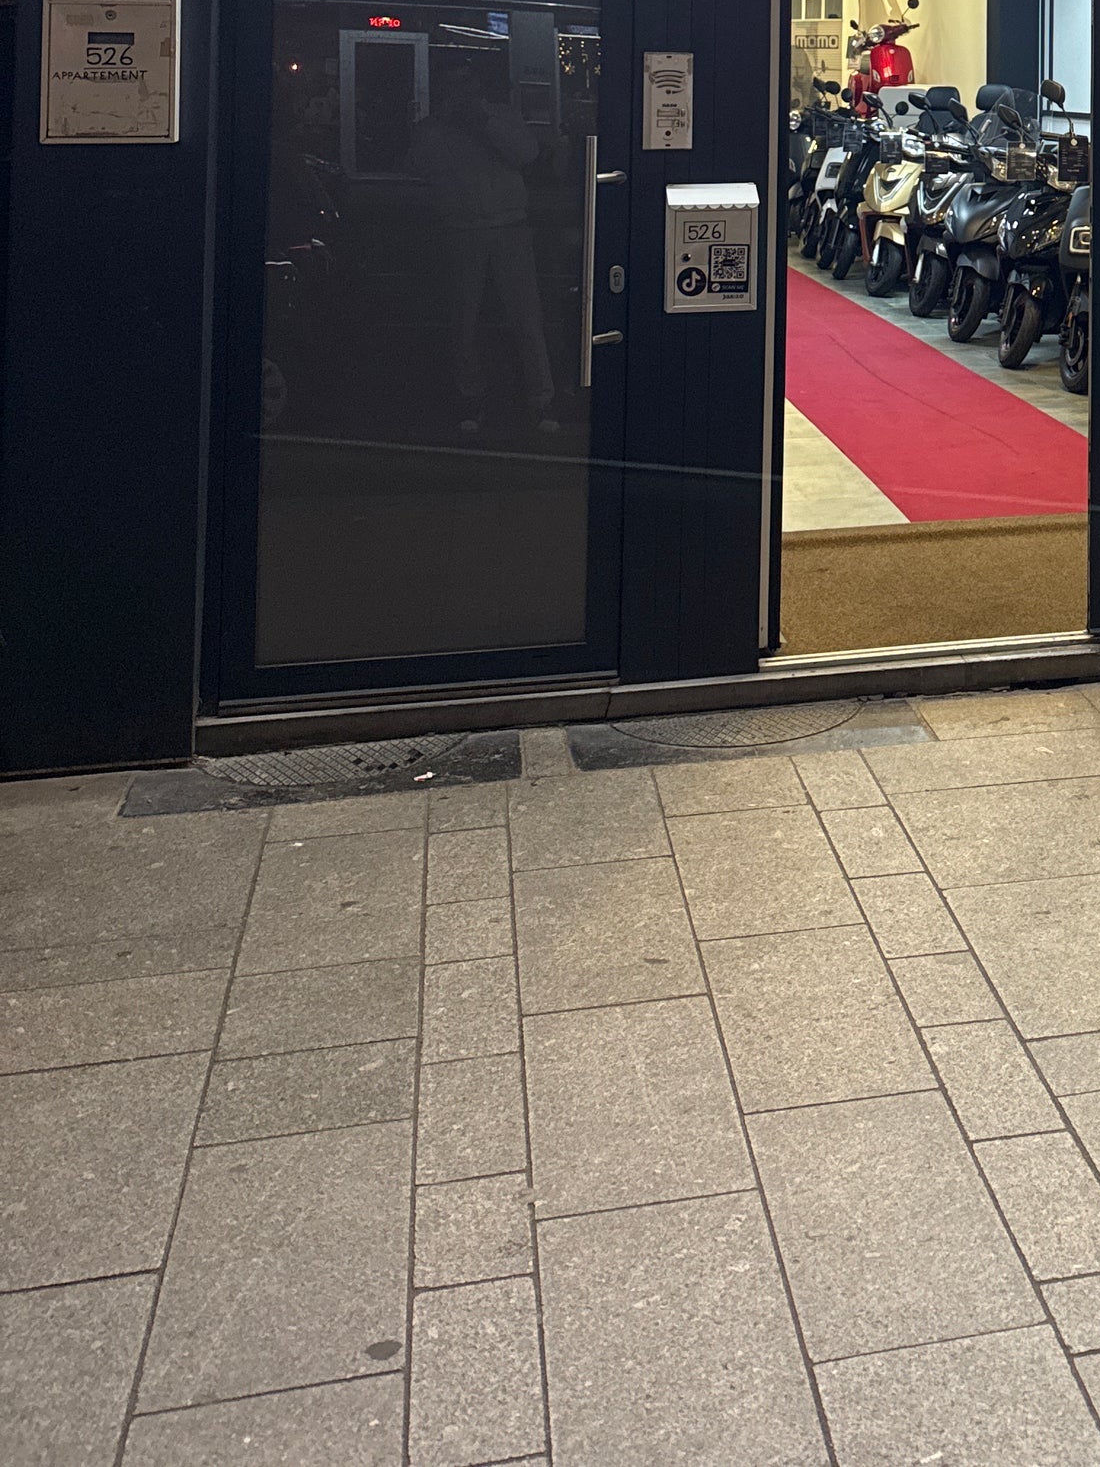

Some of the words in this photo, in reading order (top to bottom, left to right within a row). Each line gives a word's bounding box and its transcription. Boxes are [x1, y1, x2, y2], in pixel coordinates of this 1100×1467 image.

[86, 46, 134, 66] 526
[52, 69, 148, 81] APPARTEMENT
[687, 223, 722, 240] 526
